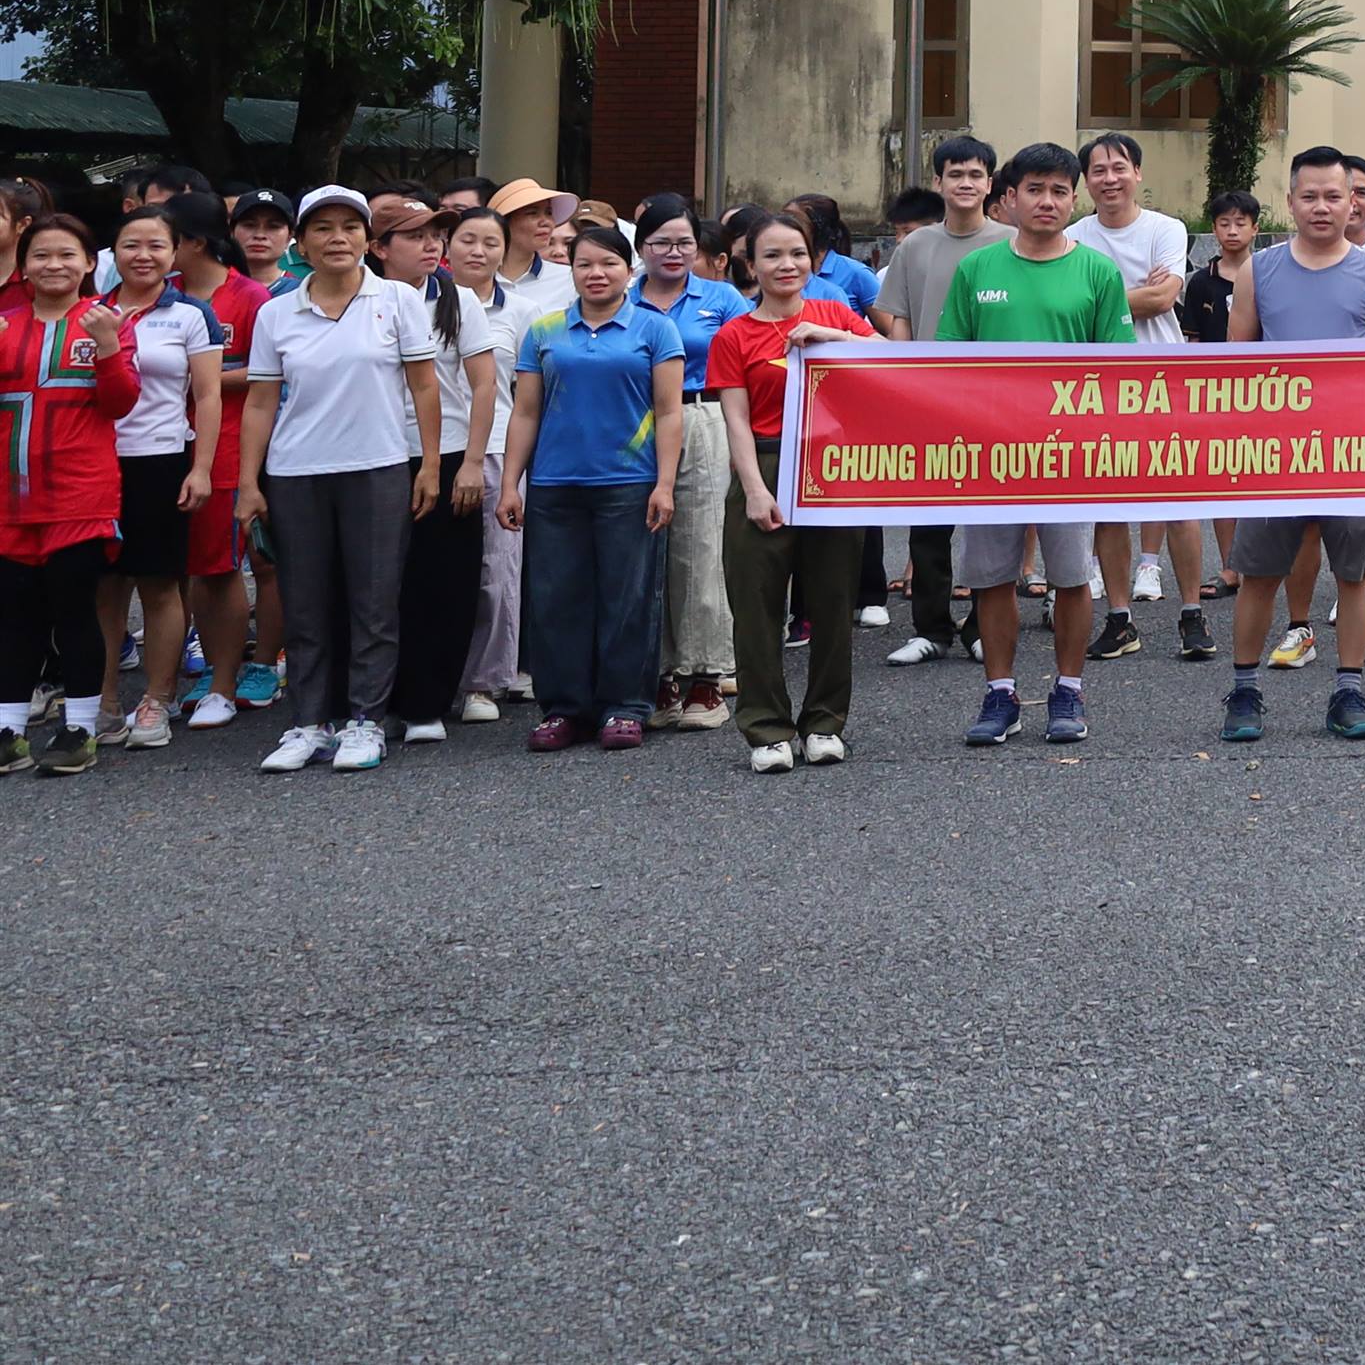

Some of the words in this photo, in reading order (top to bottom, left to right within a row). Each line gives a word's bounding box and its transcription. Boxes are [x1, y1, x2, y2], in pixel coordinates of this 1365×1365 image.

[1050, 373, 1105, 416] XÃ
[1117, 368, 1170, 415] BÁ
[1184, 366, 1314, 413] THƯỚC
[822, 444, 917, 482] CHUNG
[924, 436, 982, 489] MỘT
[990, 429, 1074, 483] QUYẾT
[1081, 433, 1140, 478] TÂM
[1147, 433, 1200, 477] XÂY
[1207, 434, 1281, 484] DỰNG
[1289, 430, 1325, 474] XÃ
